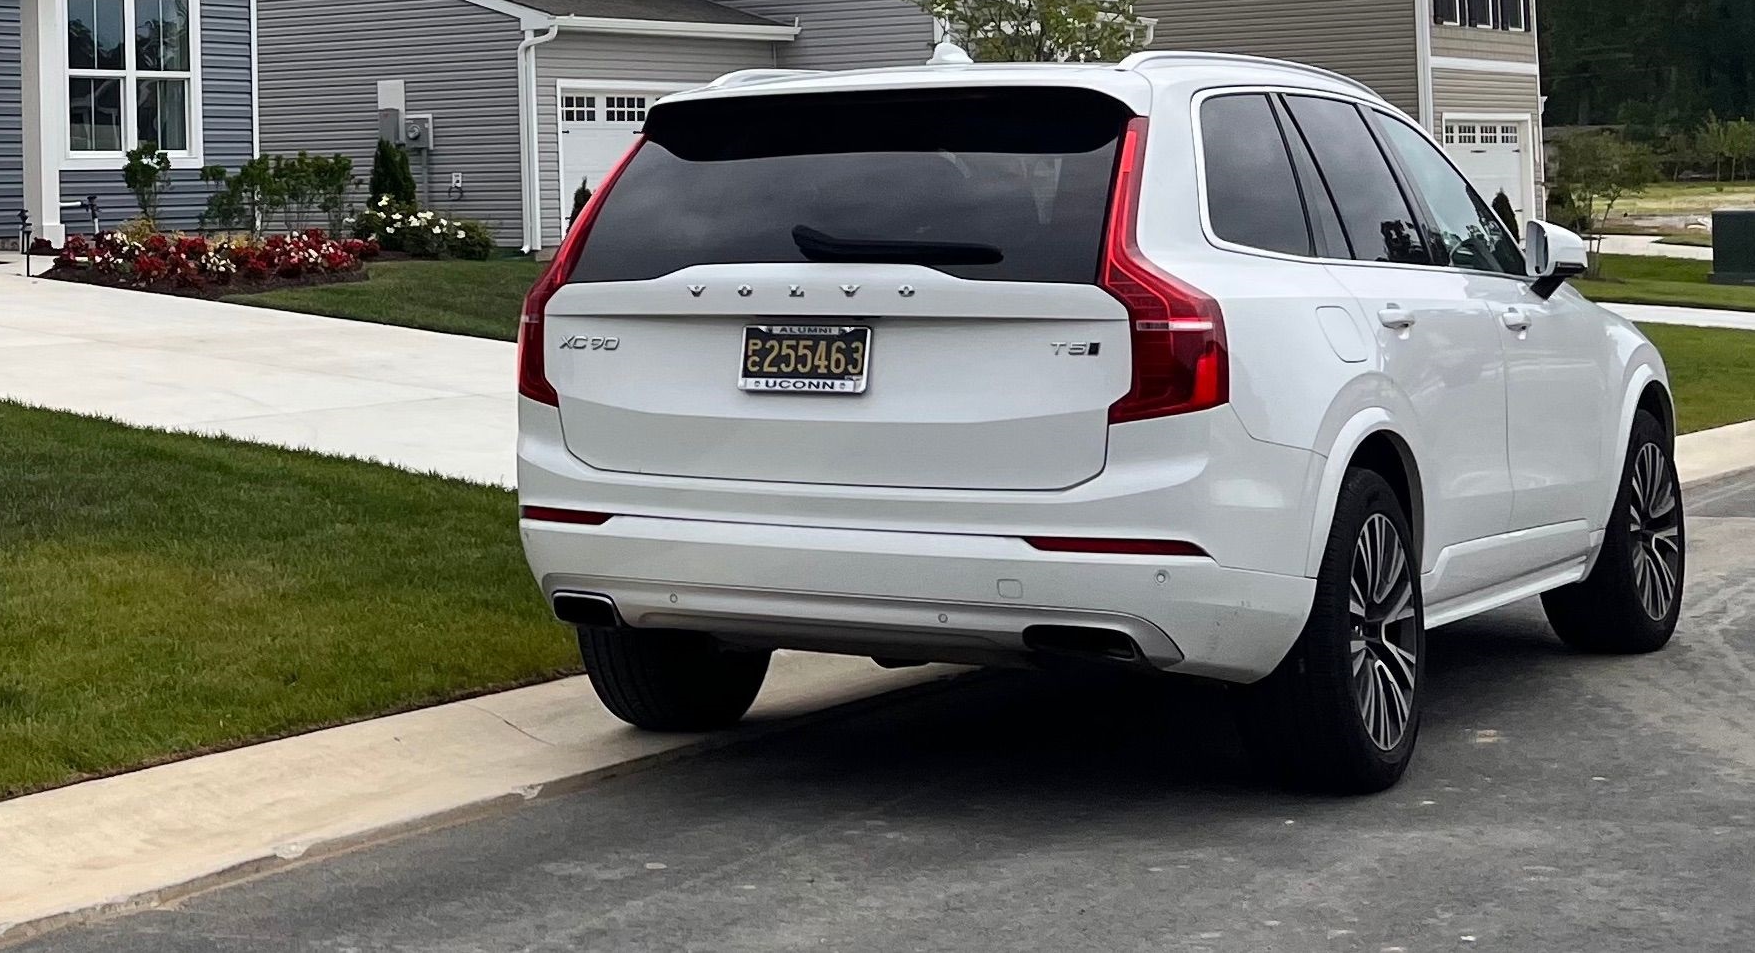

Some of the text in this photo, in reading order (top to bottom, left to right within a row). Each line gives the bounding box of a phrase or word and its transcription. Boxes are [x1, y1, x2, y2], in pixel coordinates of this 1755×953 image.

[687, 284, 915, 297] VOLVO
[559, 335, 620, 351] XC90
[1050, 341, 1087, 355] T5
[762, 339, 863, 374] 255463
[765, 380, 835, 390] UCONN
